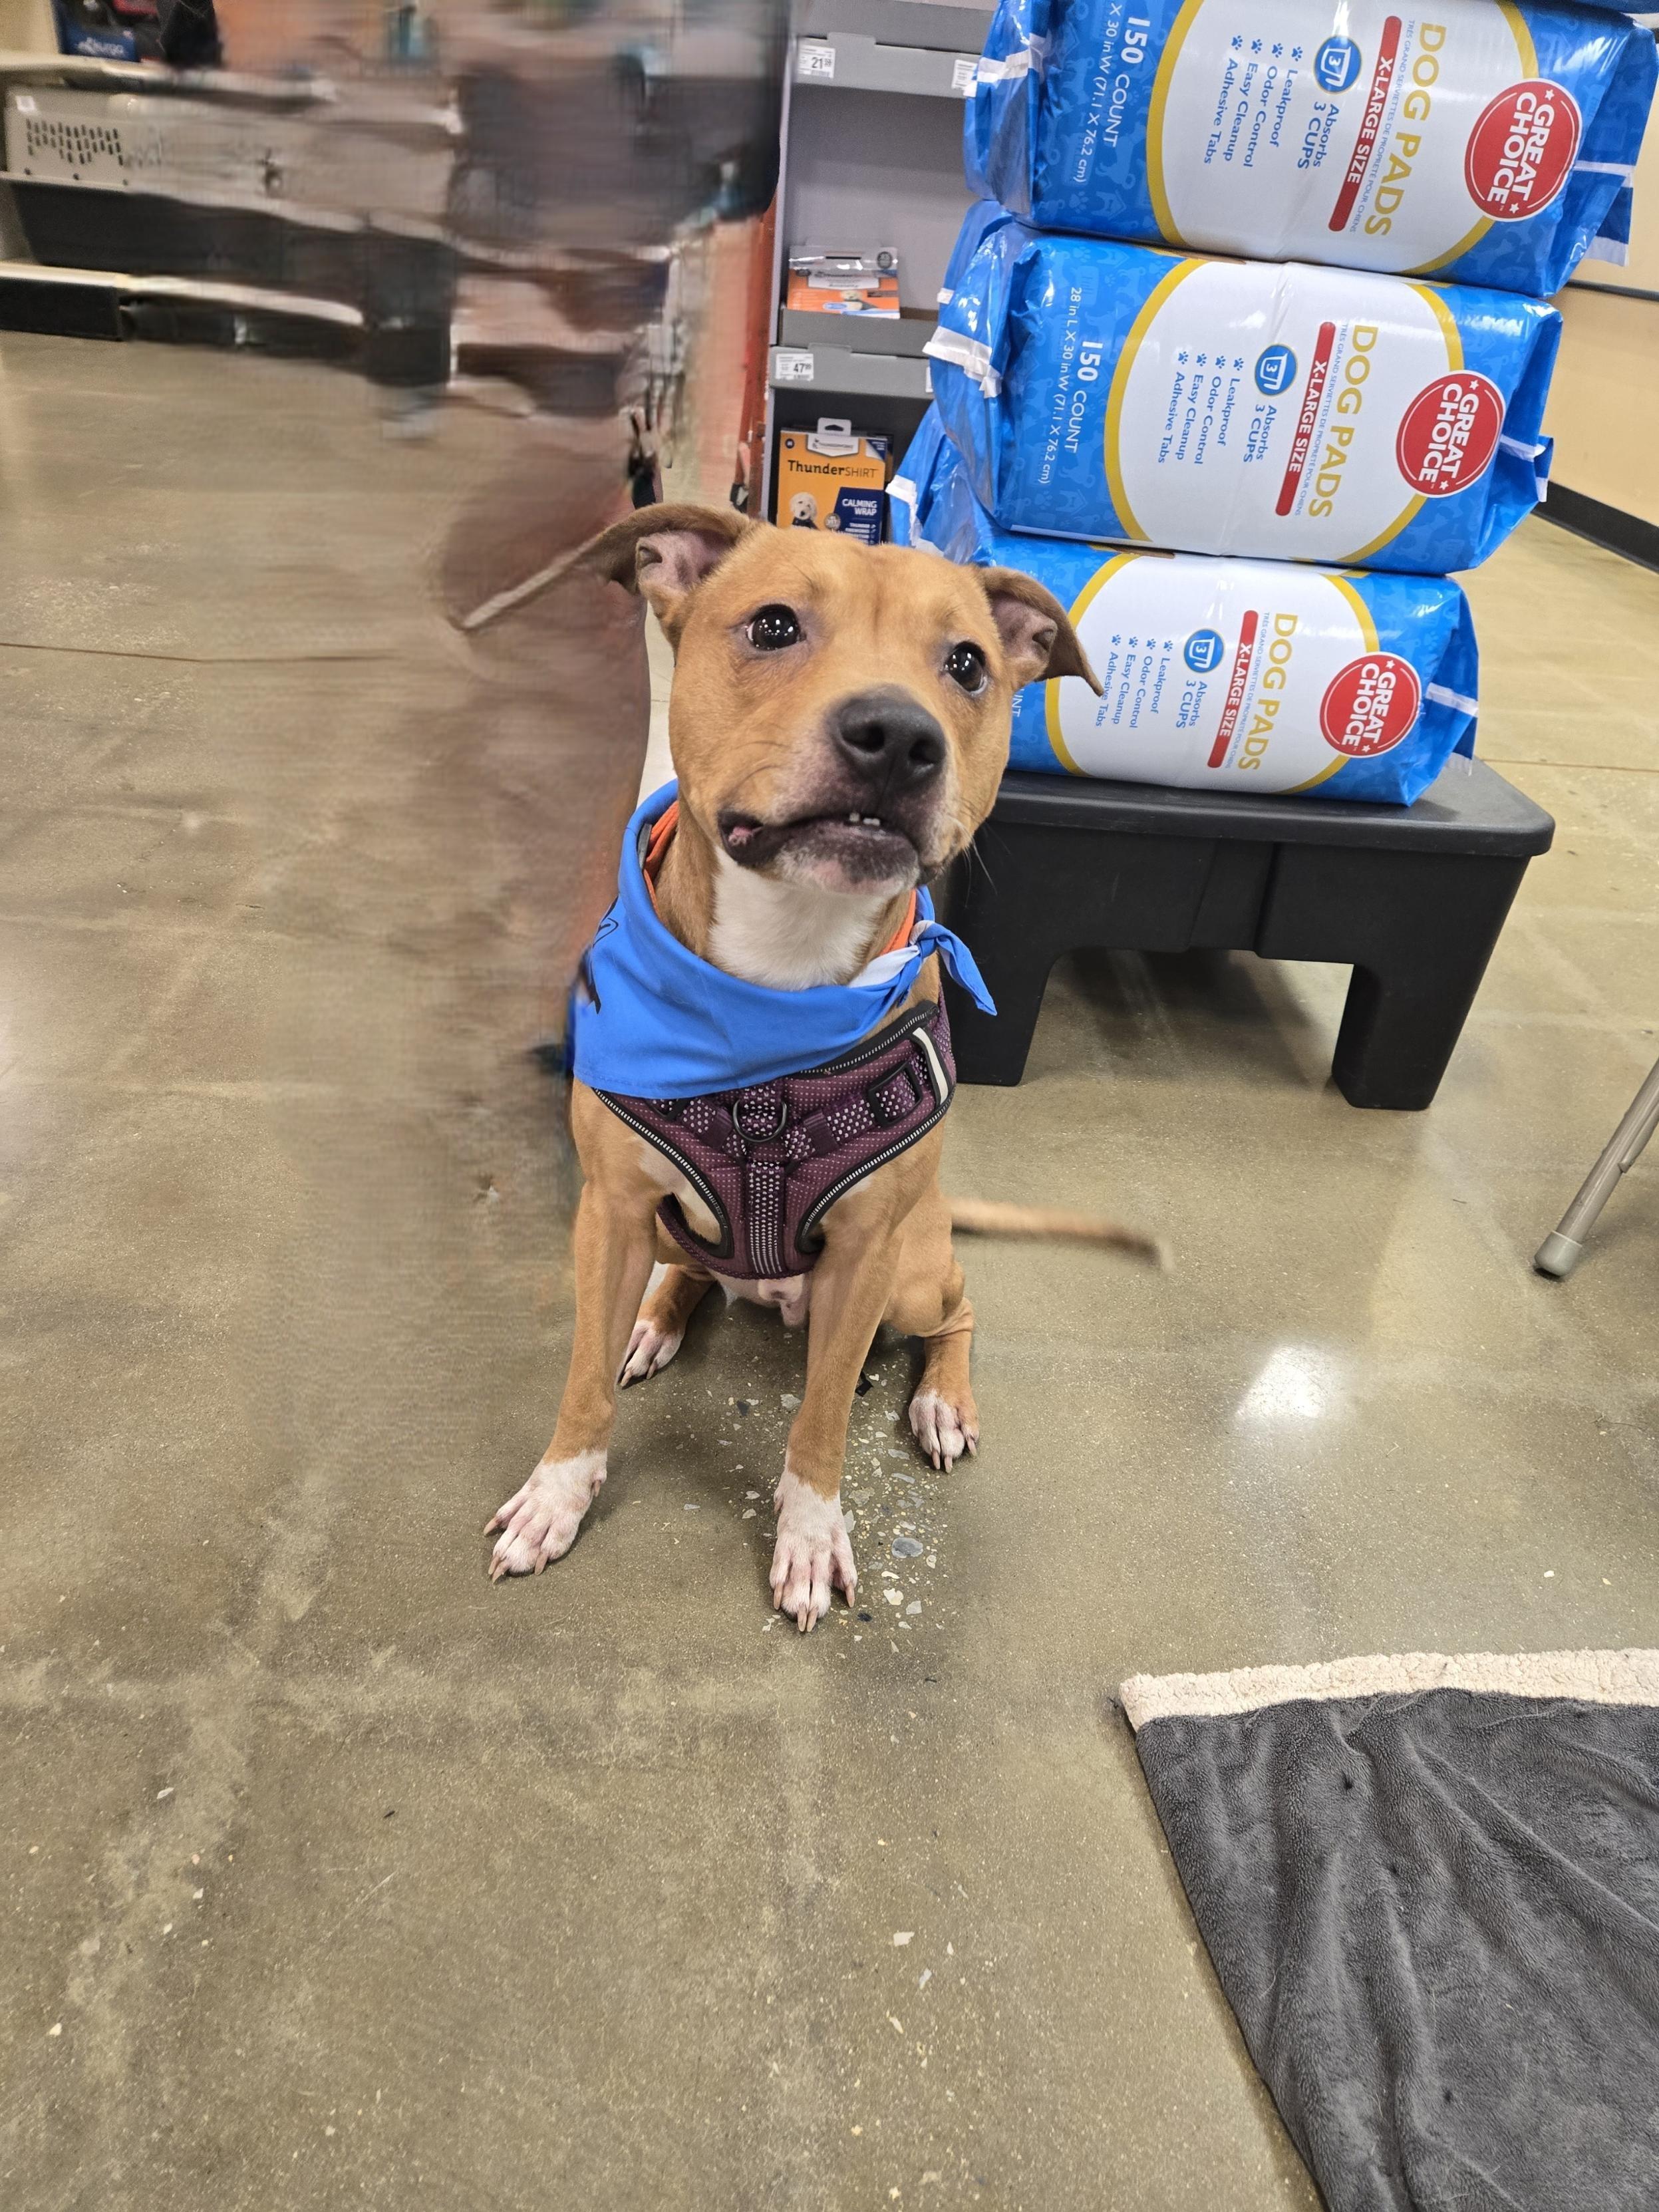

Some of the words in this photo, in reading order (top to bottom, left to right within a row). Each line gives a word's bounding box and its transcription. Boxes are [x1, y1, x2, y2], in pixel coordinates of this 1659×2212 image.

[1106, 20, 1119, 37] 30
[1110, 3, 1122, 16] X
[1121, 17, 1151, 64] 150
[1399, 40, 1411, 73] GRAND
[1239, 63, 1259, 96] Easy
[1328, 57, 1341, 65] 3
[1404, 23, 1447, 120] DOG
[1213, 58, 1239, 126] Adhesive
[1260, 65, 1277, 106] Odor
[1361, 56, 1393, 138] X-LARGE
[1388, 73, 1405, 121] SERVIETTES
[1087, 112, 1100, 126] X
[1104, 74, 1130, 147] COUNT
[1269, 69, 1298, 148] Leakproof
[1314, 101, 1326, 111] 3
[1081, 129, 1097, 156] 76.2
[1204, 131, 1222, 164] Tabs
[1223, 100, 1249, 161] Cleanup
[1243, 110, 1267, 167] Control
[1297, 117, 1321, 169] CUPS
[1313, 104, 1340, 167] Absorbs
[1384, 122, 1392, 136] DE
[1487, 92, 1537, 204] CHOICE
[1073, 159, 1087, 183] cm)
[1347, 144, 1370, 184] SIZE
[1512, 104, 1555, 201] GREAT
[1362, 180, 1374, 204] POUR
[1364, 132, 1422, 236] PADS
[1350, 204, 1366, 232] CHIENS
[1068, 304, 1079, 316] in
[1070, 287, 1082, 302] 28
[1062, 344, 1075, 360] 30
[1065, 329, 1076, 342] X
[1077, 341, 1103, 381] 150
[1334, 343, 1344, 373] GRAND
[1337, 325, 1379, 414] DOG
[1165, 372, 1185, 430] Adhesive
[1187, 374, 1203, 404] Easy
[1207, 376, 1221, 412] Odor
[1255, 404, 1265, 412] 3
[1299, 360, 1327, 434] X-LARGE
[1323, 376, 1337, 417] SERVIETTES
[1049, 424, 1062, 436] X
[1064, 391, 1087, 453] COUNT
[1217, 378, 1240, 446] Leakproof
[1320, 417, 1326, 428] DE
[1044, 439, 1059, 462] 76.2
[1158, 434, 1173, 463] Tabs
[1175, 408, 1196, 460] Cleanup
[1194, 415, 1213, 464] Control
[1243, 418, 1261, 462] CUPS
[1256, 405, 1277, 460] Absorbs
[1418, 383, 1462, 482] CHOICE
[1441, 394, 1479, 478] GREAT
[788, 460, 879, 478] ThunderSHIRT
[1038, 464, 1051, 484] cm)
[1288, 438, 1308, 473] SIZE
[1308, 425, 1355, 518] PADS
[1303, 472, 1312, 489] POUR
[842, 498, 877, 508] CALMING
[854, 507, 877, 516] WRAP
[1122, 654, 1135, 679] Easy
[1139, 656, 1153, 685] Odor
[1263, 613, 1298, 689] DOG
[1102, 651, 1119, 701] Adhesive
[1151, 657, 1170, 714] Leakproof
[1228, 643, 1252, 705] X-LARGE
[1096, 704, 1109, 727] Tabs
[1113, 682, 1130, 724] Cleanup
[1130, 689, 1145, 728] Control
[1176, 692, 1193, 728] CUPS
[1189, 681, 1207, 726] Absorbs
[1219, 709, 1237, 737] SIZE
[1342, 663, 1380, 746] CHOICE
[1362, 672, 1396, 743] GREAT
[1238, 699, 1280, 770] PADS
